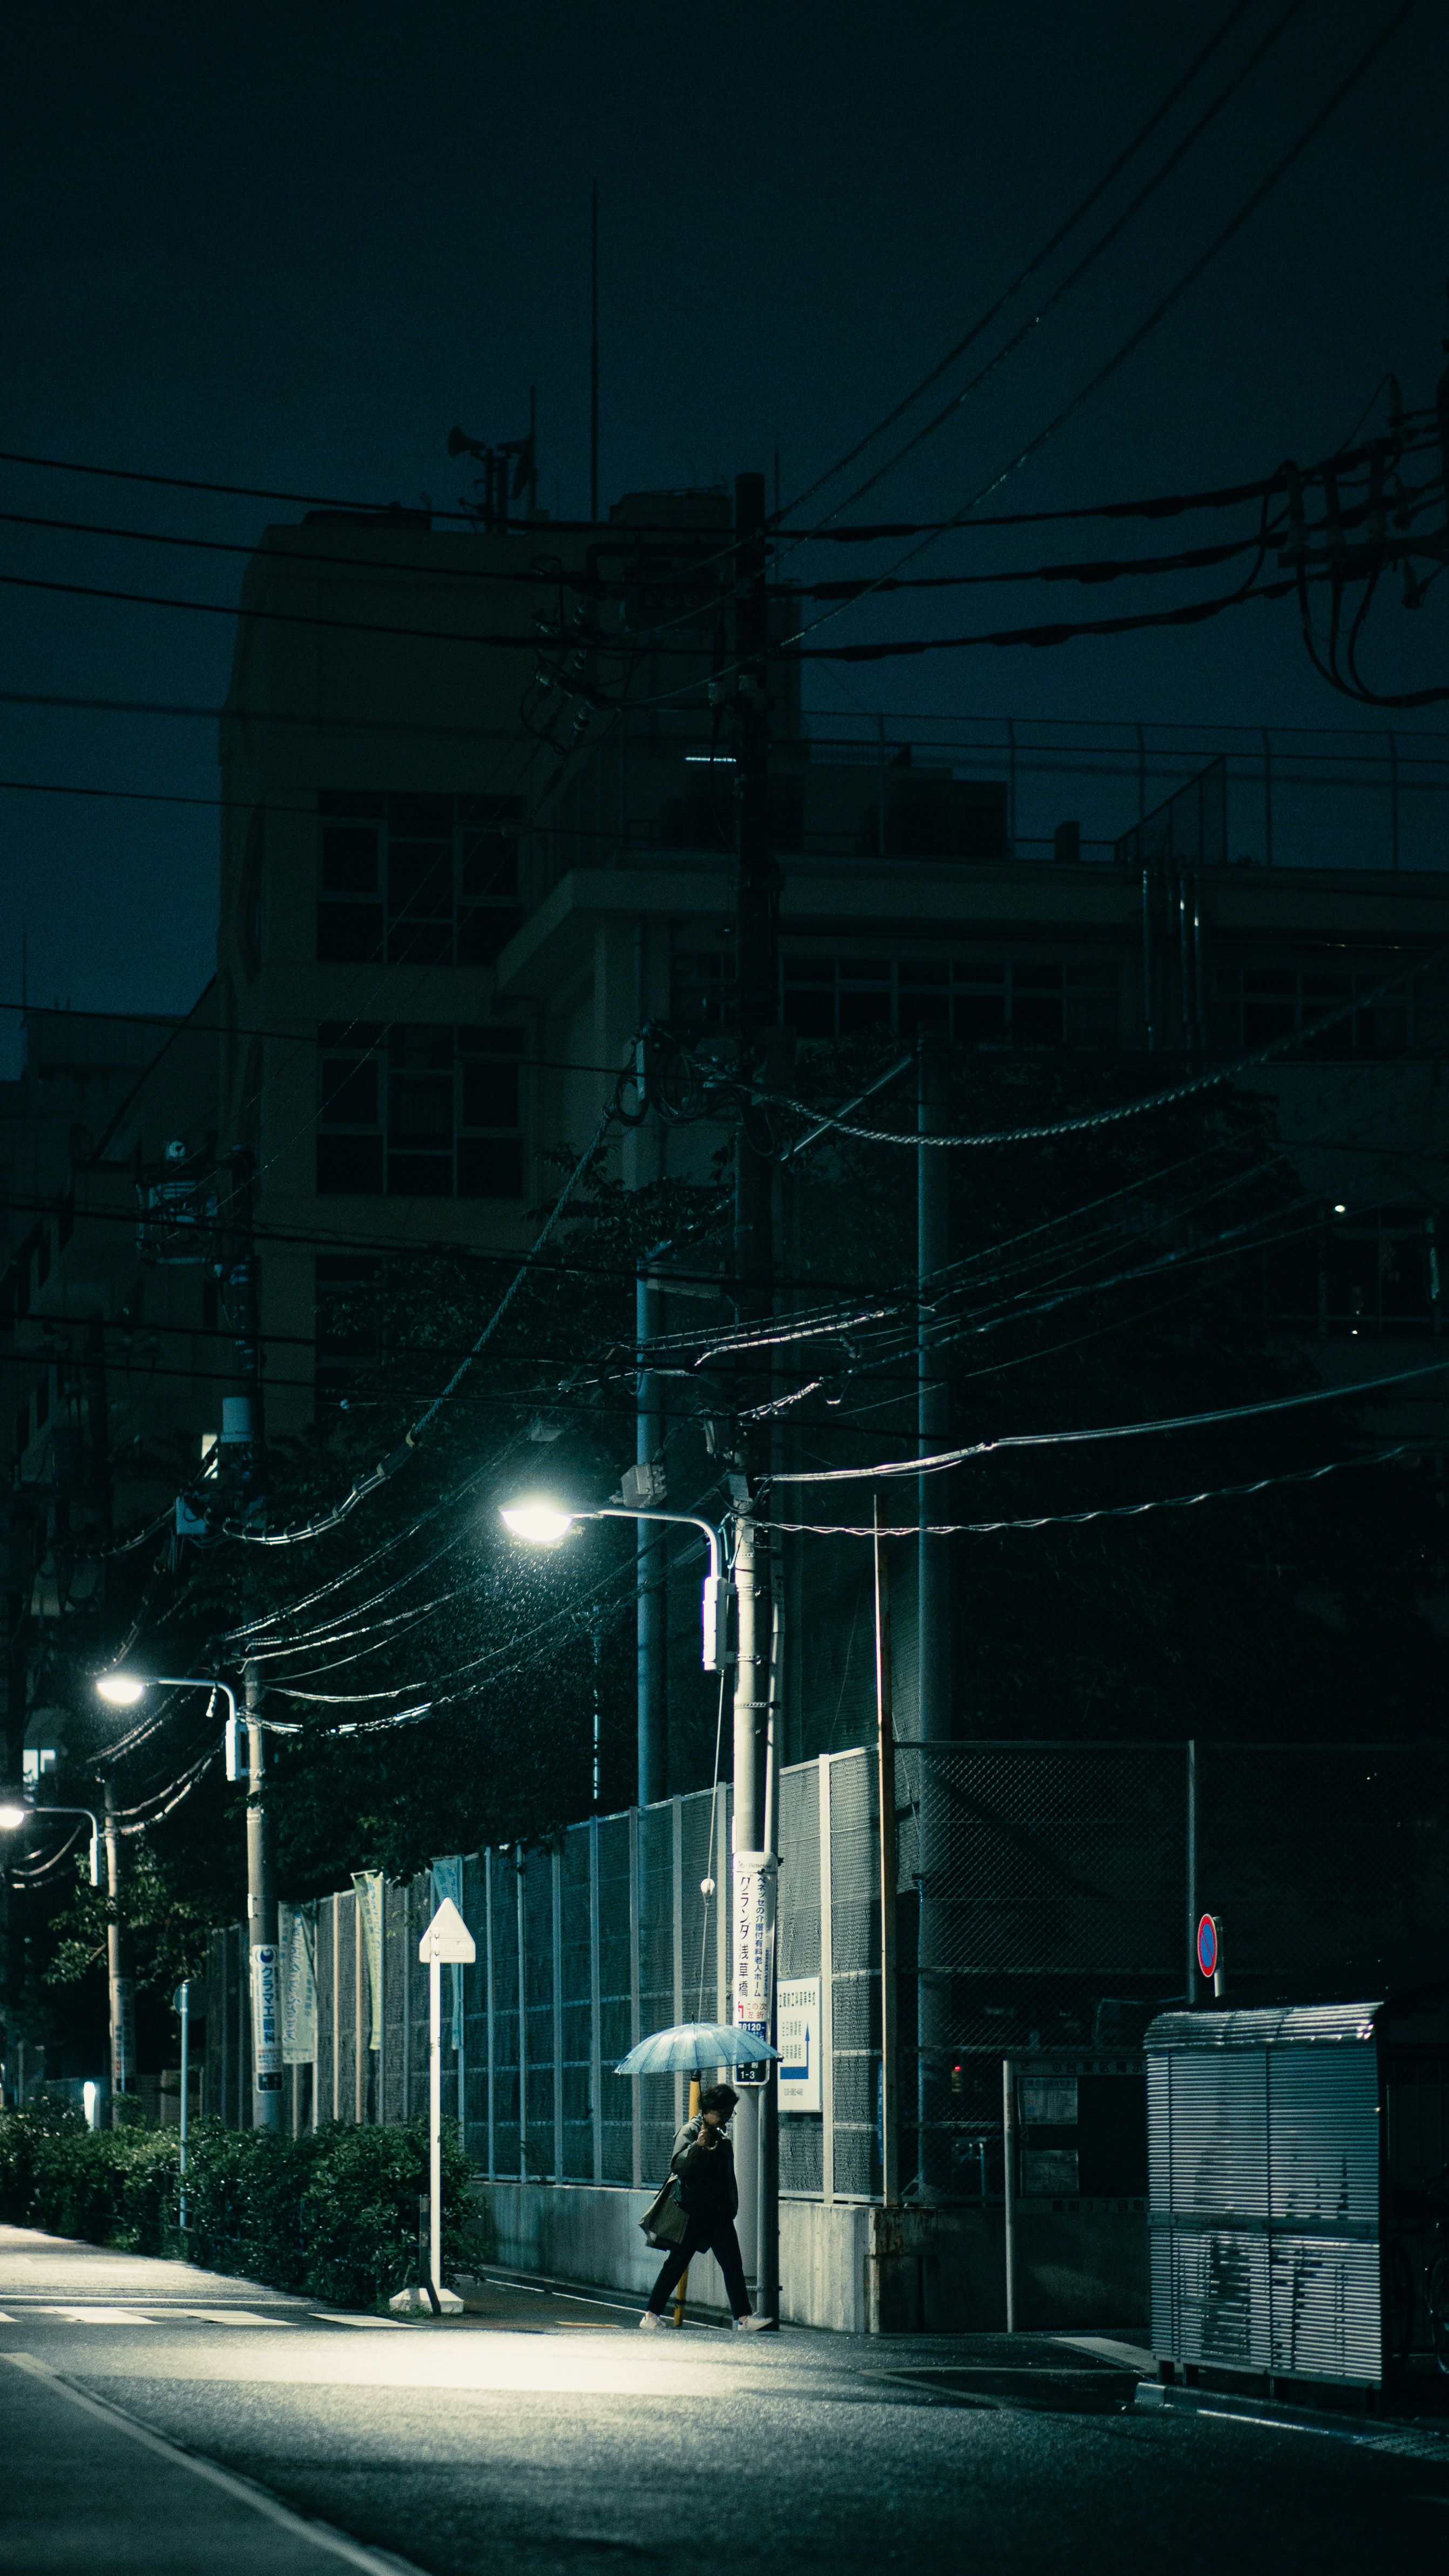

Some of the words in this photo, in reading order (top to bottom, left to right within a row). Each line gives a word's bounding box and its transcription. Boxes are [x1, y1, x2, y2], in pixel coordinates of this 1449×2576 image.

[739, 1875, 753, 1997] グランダ浅草橋
[740, 2071, 755, 2079] 1-3
